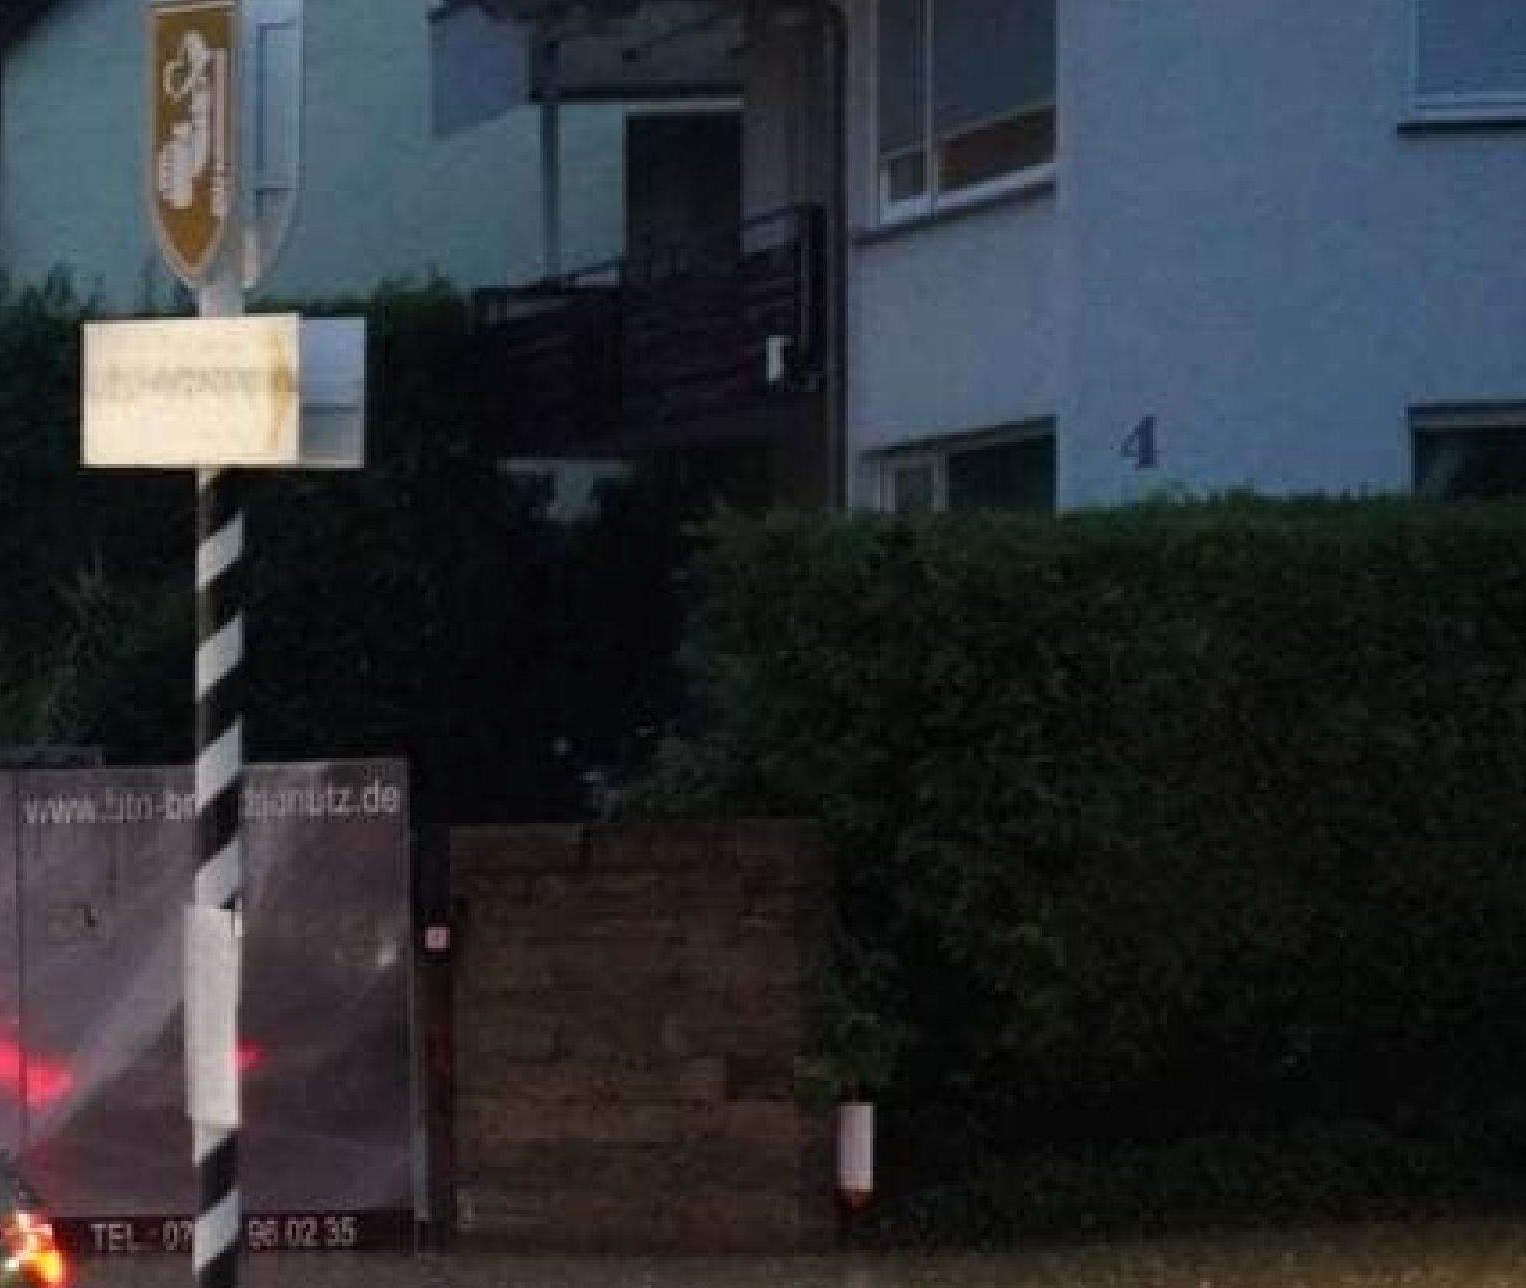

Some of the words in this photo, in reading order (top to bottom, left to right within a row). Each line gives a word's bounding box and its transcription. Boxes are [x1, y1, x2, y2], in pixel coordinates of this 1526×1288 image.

[1120, 414, 1158, 469] 4
[286, 1216, 319, 1248] 02
[323, 1215, 359, 1248] 35
